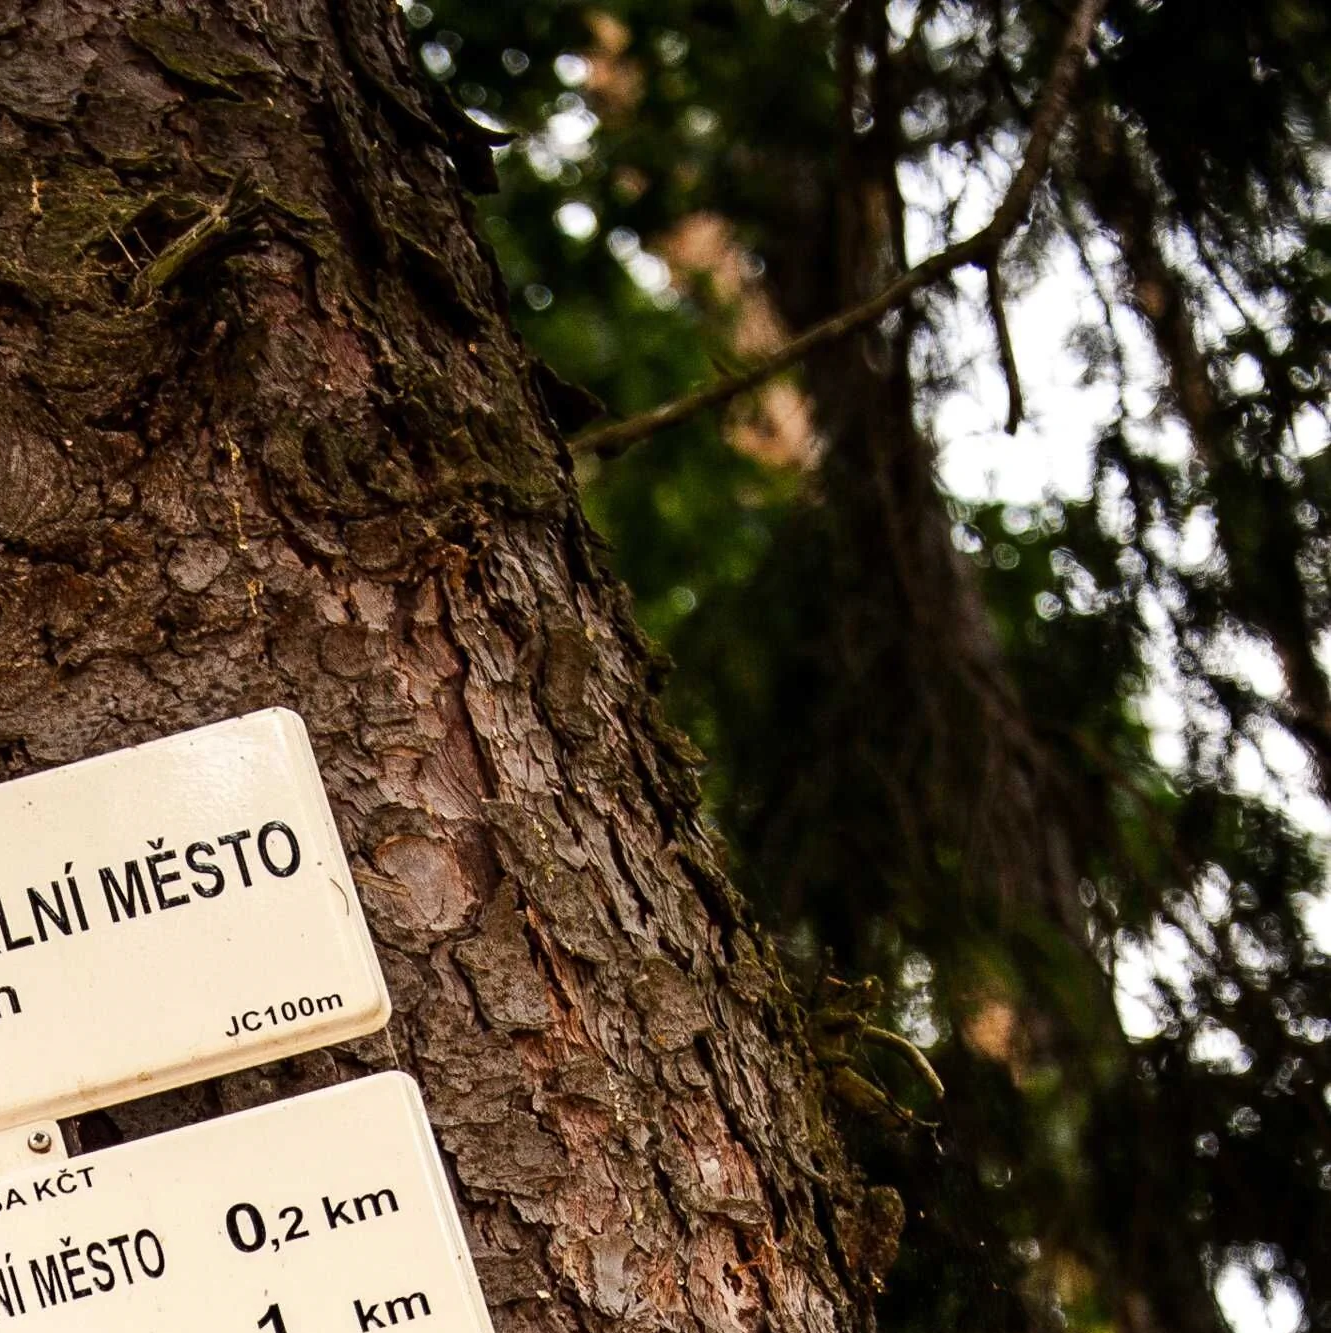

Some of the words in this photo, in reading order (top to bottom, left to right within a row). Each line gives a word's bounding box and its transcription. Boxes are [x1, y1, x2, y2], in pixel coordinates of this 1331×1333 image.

[97, 819, 302, 924] MĚSTO
[224, 992, 344, 1039] JC100m
[32, 1165, 95, 1203] KČT
[27, 1227, 166, 1310] MĚSTO
[224, 1201, 311, 1254] 0,2
[320, 1187, 401, 1231] km
[352, 1290, 433, 1333] km
